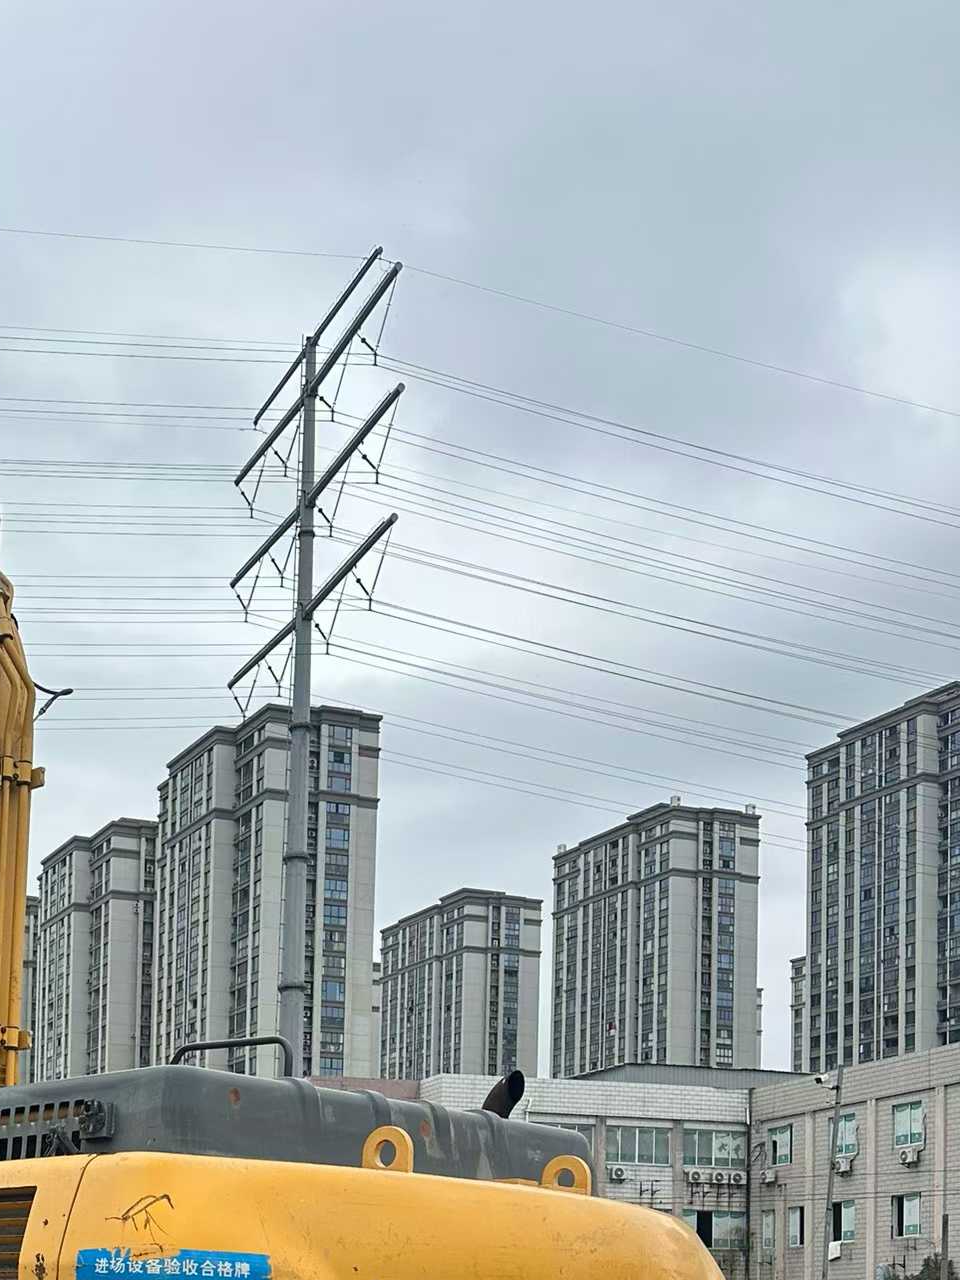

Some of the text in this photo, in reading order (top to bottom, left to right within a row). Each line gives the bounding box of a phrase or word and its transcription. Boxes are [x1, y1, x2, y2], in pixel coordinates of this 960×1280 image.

[95, 1257, 251, 1279] 进场设备验收合格牌
